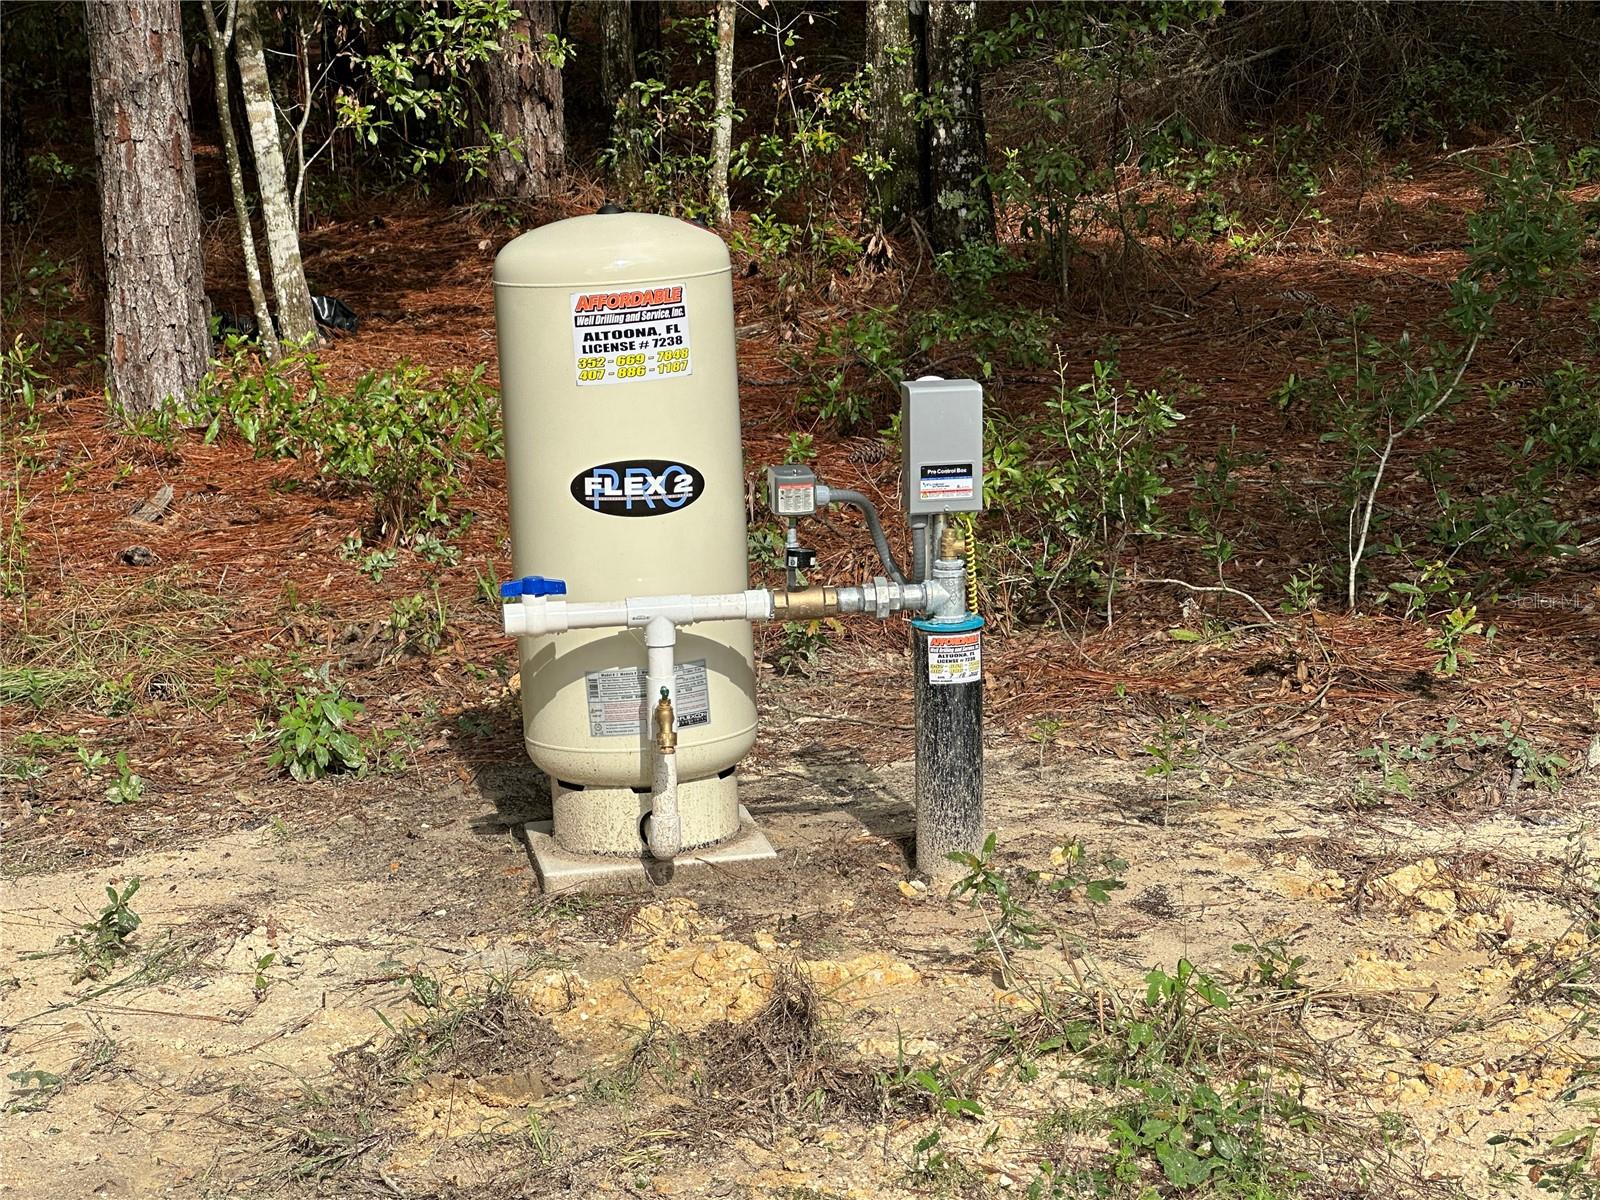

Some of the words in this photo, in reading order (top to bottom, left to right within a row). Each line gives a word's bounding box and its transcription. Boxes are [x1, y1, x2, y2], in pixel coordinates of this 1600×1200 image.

[575, 287, 683, 313] AFFORDABLE
[576, 315, 594, 326] Well
[595, 313, 624, 326] Drilling
[625, 311, 640, 322] and
[671, 306, 684, 317] Inc.
[583, 326, 662, 342] ALTOONA,
[666, 324, 681, 334] FL
[582, 341, 636, 354] LICENSE
[652, 336, 683, 348] 7238
[584, 476, 667, 496] FLEX
[673, 474, 694, 493] 2
